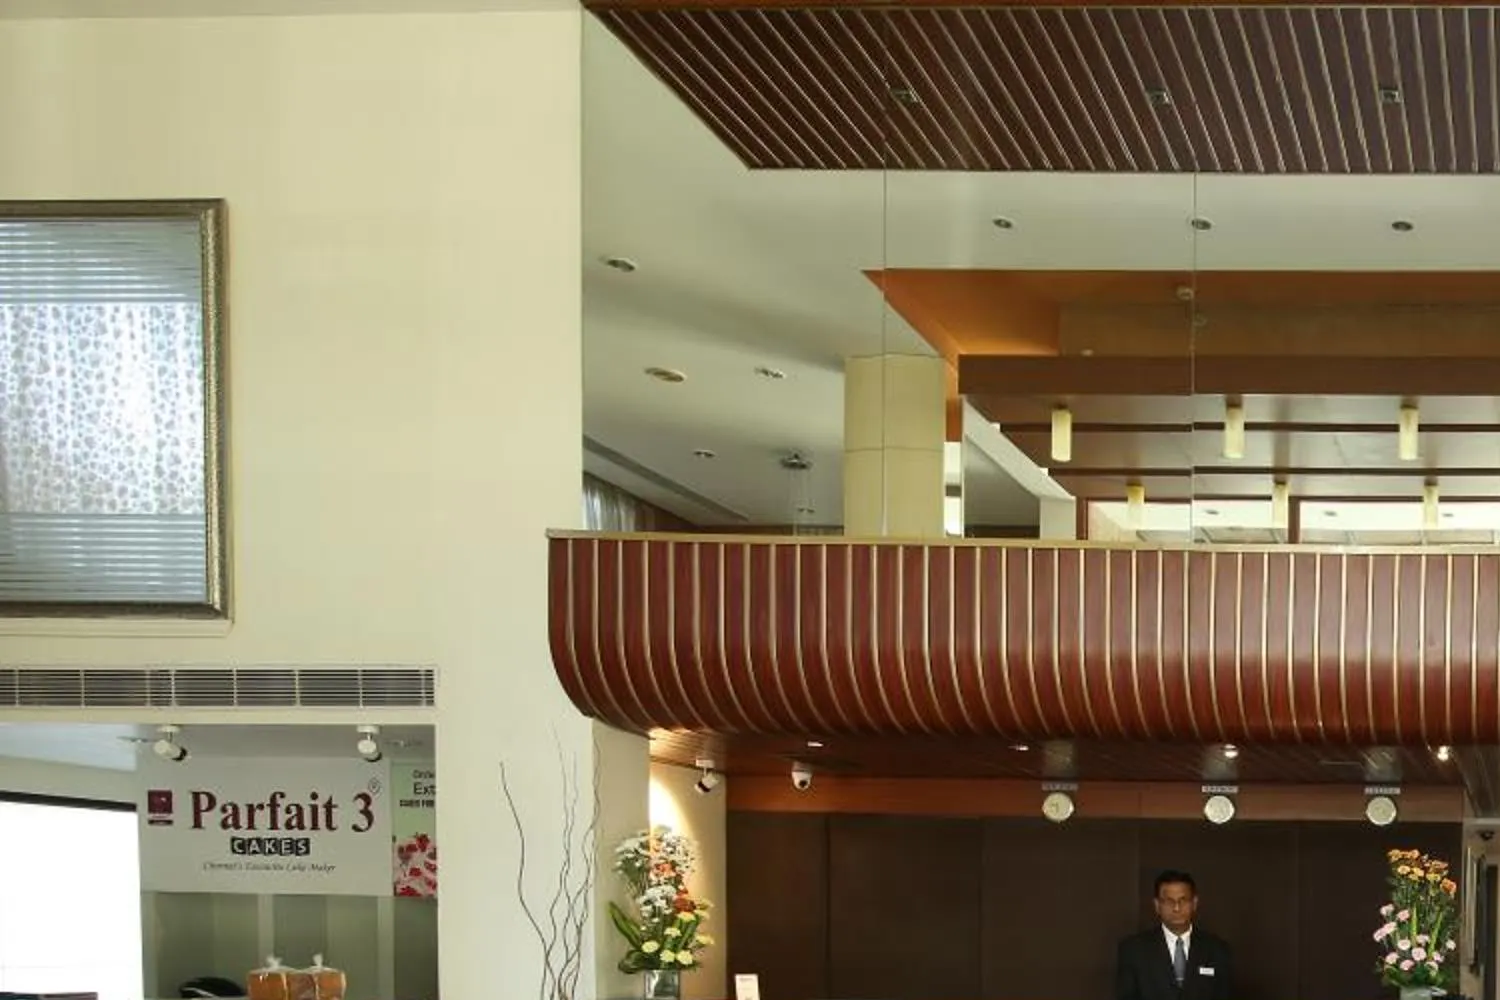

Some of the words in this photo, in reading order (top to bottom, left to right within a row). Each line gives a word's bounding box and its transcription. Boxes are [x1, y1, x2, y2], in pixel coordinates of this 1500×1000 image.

[190, 790, 338, 831] Parfait
[351, 792, 376, 832] 3
[231, 837, 311, 856] CAKES
